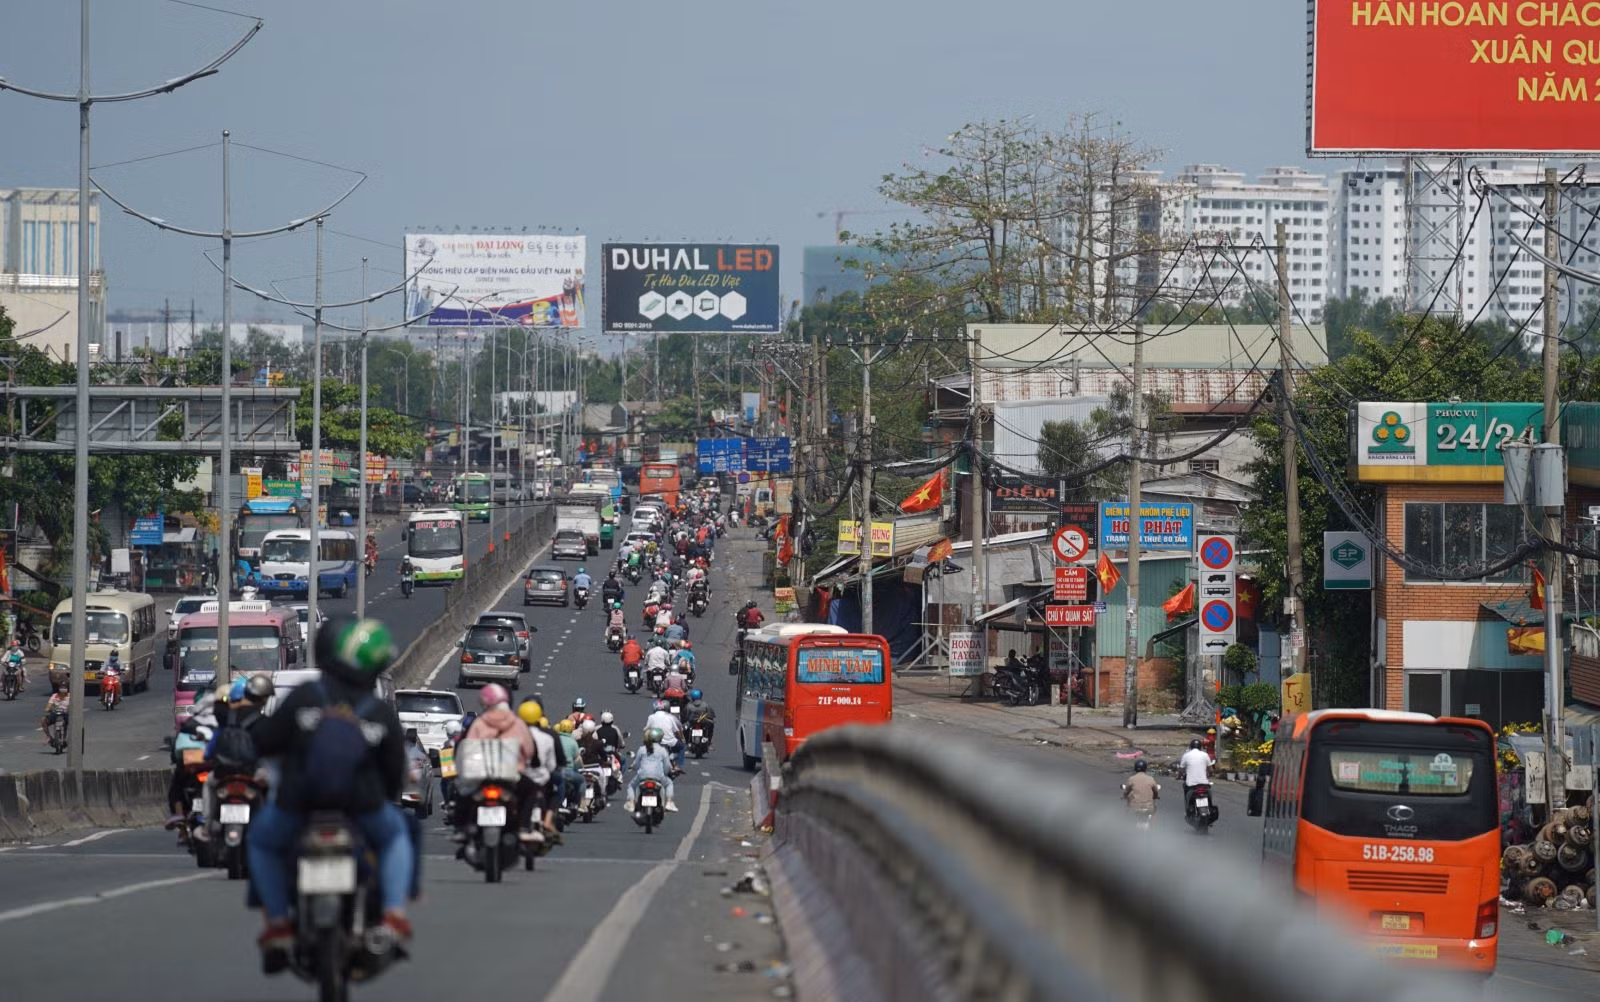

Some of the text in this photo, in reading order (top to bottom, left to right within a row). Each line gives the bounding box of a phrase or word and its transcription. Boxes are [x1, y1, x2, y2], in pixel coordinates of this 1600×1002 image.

[1421, 1, 1508, 26] HOAN
[1470, 33, 1552, 64] XUÂN
[1518, 71, 1588, 101] NĂM
[496, 240, 524, 251] LONG
[612, 248, 773, 271] DUHAL LED
[554, 267, 571, 275] NAM
[697, 274, 720, 286] LED
[1437, 417, 1538, 450] 24/24
[1338, 549, 1358, 557] SP
[1047, 607, 1059, 622] CHÚ
[1060, 607, 1064, 622] Ý
[1065, 610, 1081, 622] QUAN
[1082, 607, 1093, 622] SÁT
[951, 640, 981, 649] HONDA
[951, 651, 981, 660] TAYGA
[807, 657, 840, 673] MINH
[1384, 824, 1418, 833] THACO
[1363, 844, 1435, 863] 51B-258.98
